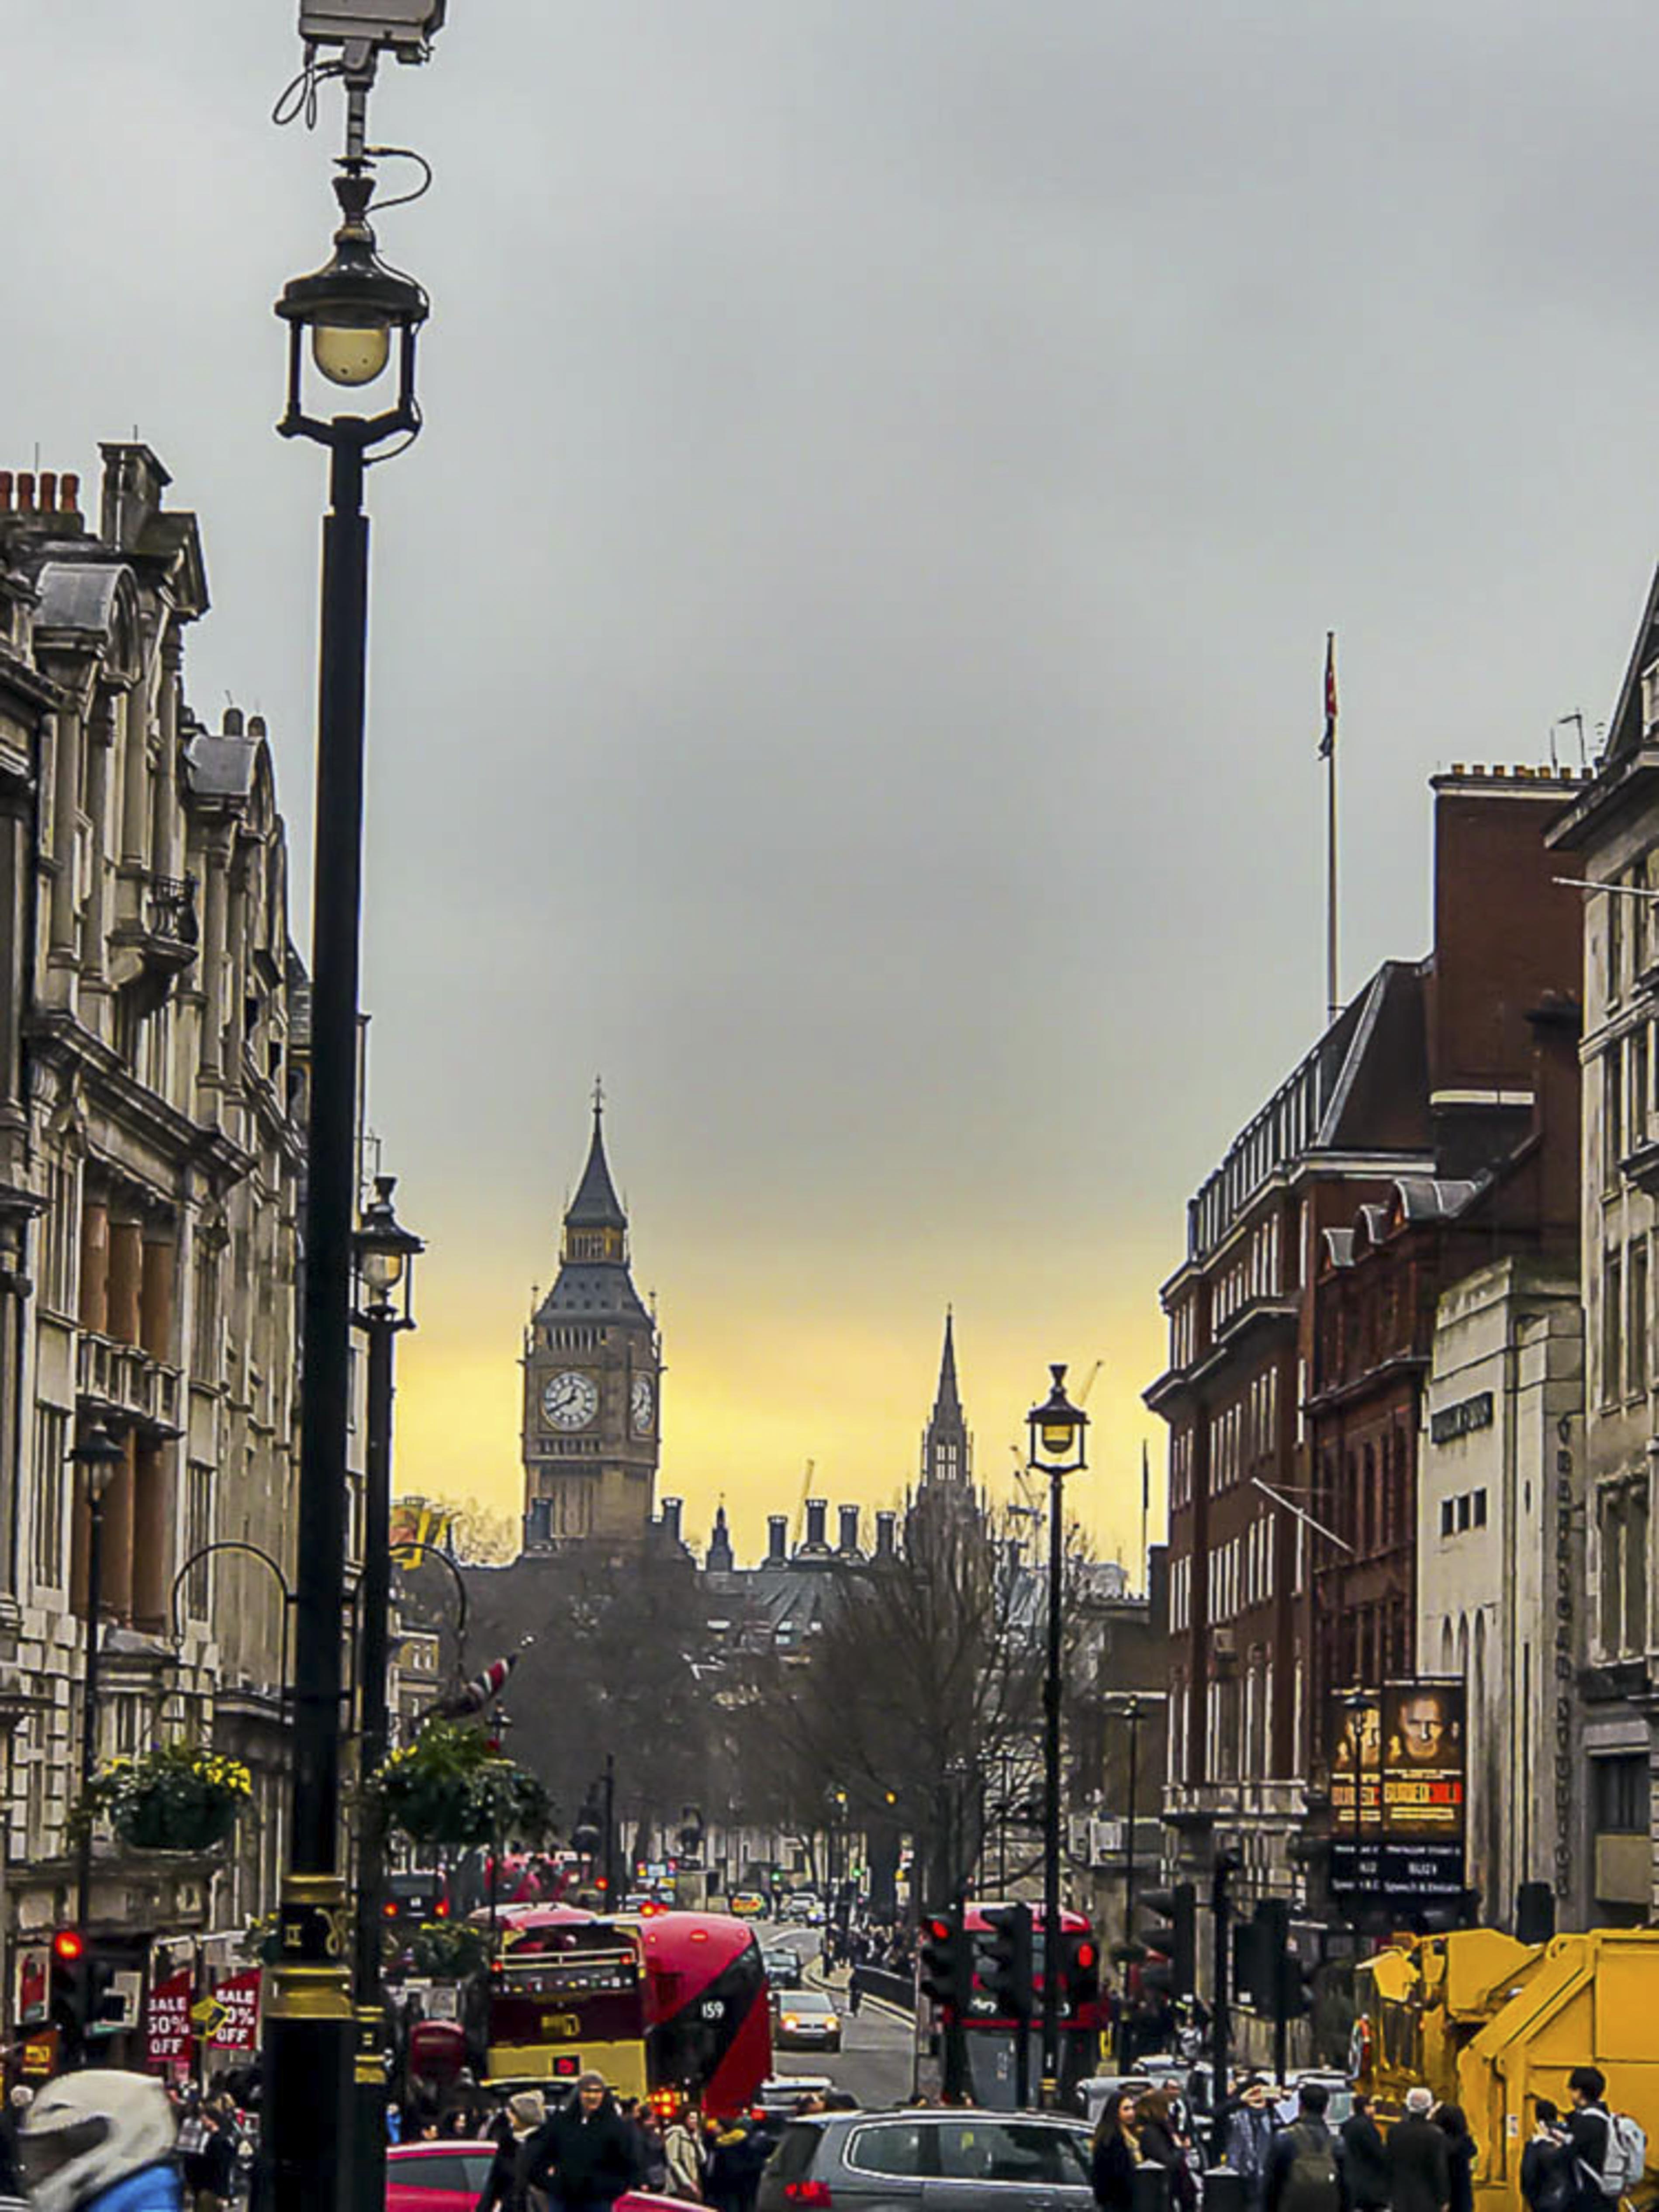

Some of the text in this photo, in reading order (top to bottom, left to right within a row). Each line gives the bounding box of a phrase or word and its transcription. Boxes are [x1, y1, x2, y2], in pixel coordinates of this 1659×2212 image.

[148, 1996, 186, 2011] SALE
[216, 1990, 255, 2005] SALE
[227, 2006, 255, 2025] 0%
[702, 2001, 724, 2018] 159
[217, 2028, 248, 2043] OFF
[150, 2039, 183, 2053] OFF
